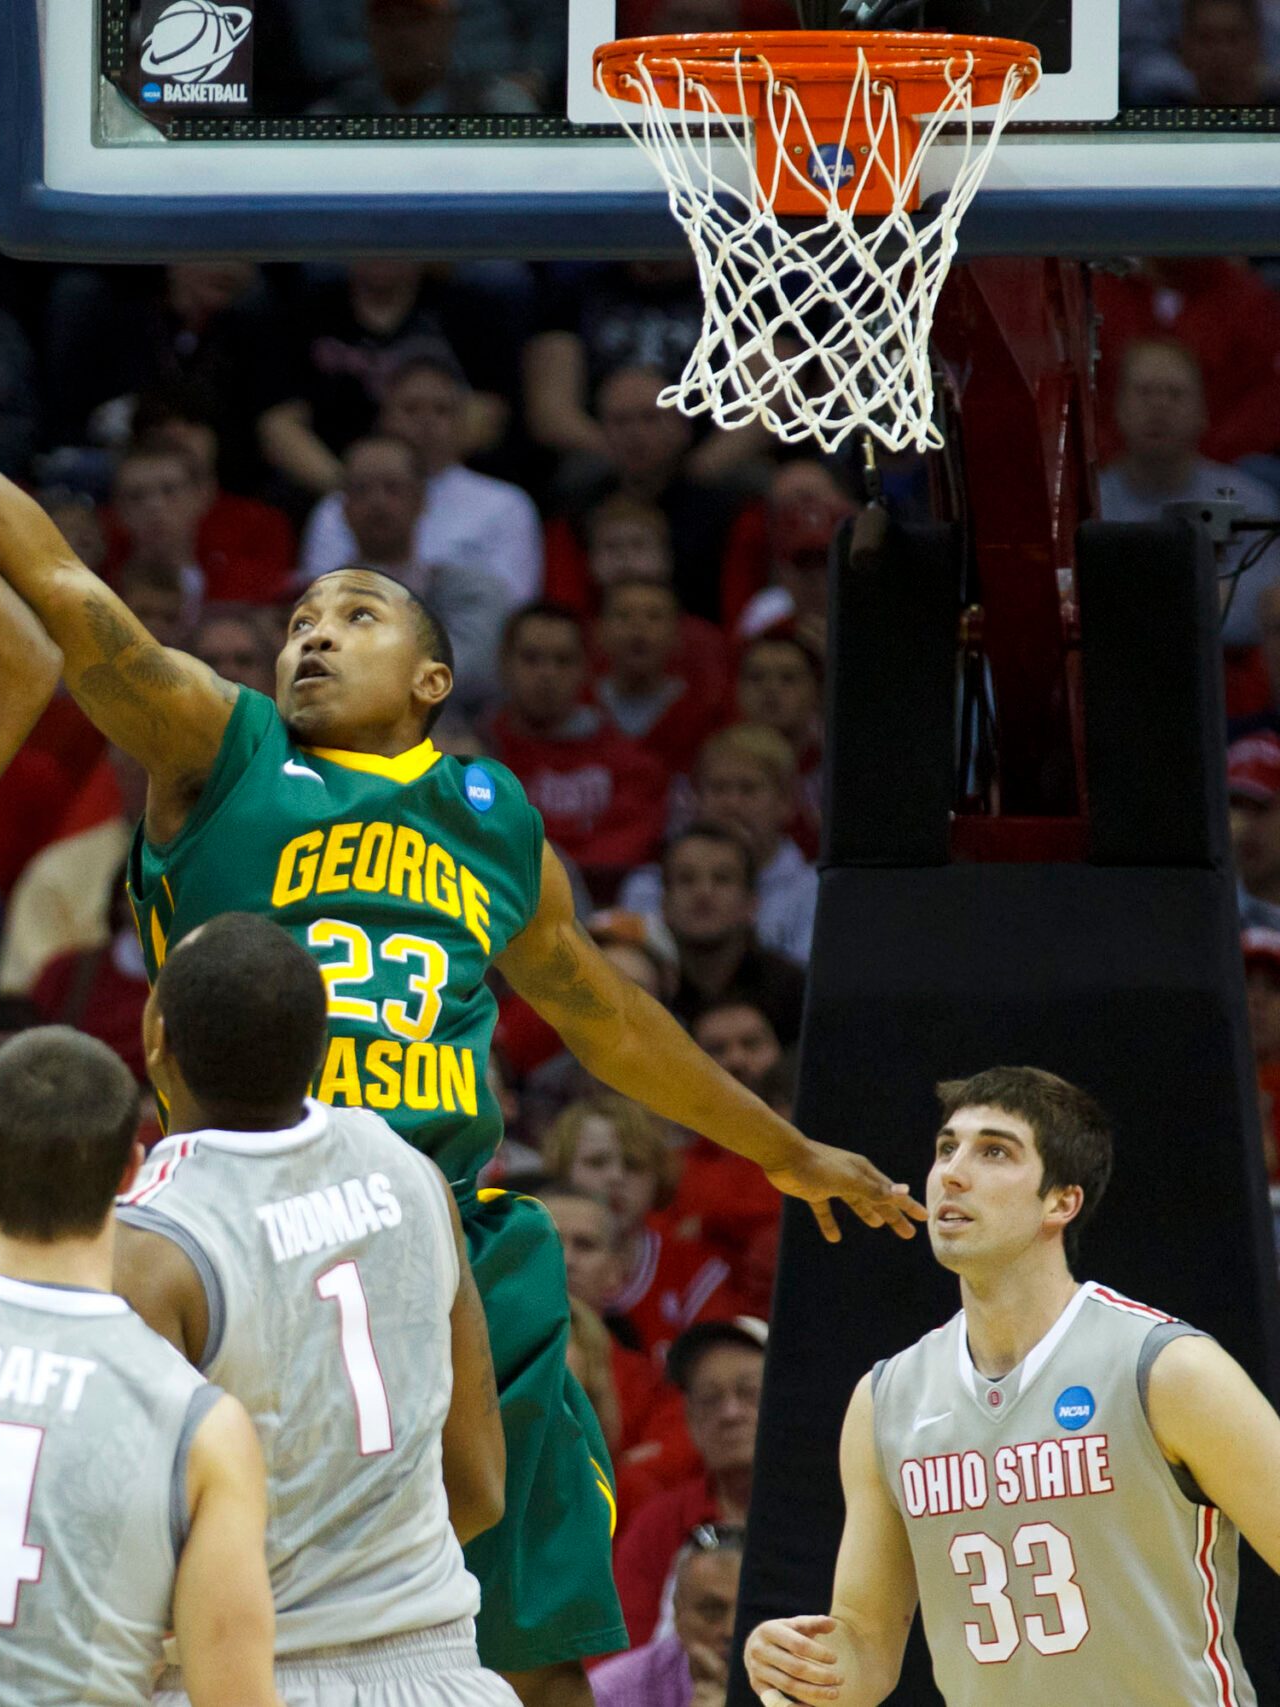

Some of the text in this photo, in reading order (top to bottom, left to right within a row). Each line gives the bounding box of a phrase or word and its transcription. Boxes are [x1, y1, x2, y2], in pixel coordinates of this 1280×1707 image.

[163, 83, 248, 102] BASKETBALL
[467, 785, 492, 800] NCAA
[272, 821, 492, 955] GEORGE
[308, 918, 449, 1041] 23
[305, 1036, 478, 1116] ASON
[256, 1172, 403, 1263] THOMAS
[315, 1259, 394, 1456] 1
[1059, 1405, 1090, 1417] NCAA
[900, 1434, 1114, 1518] OHIO STATE
[948, 1521, 1091, 1664] 33
